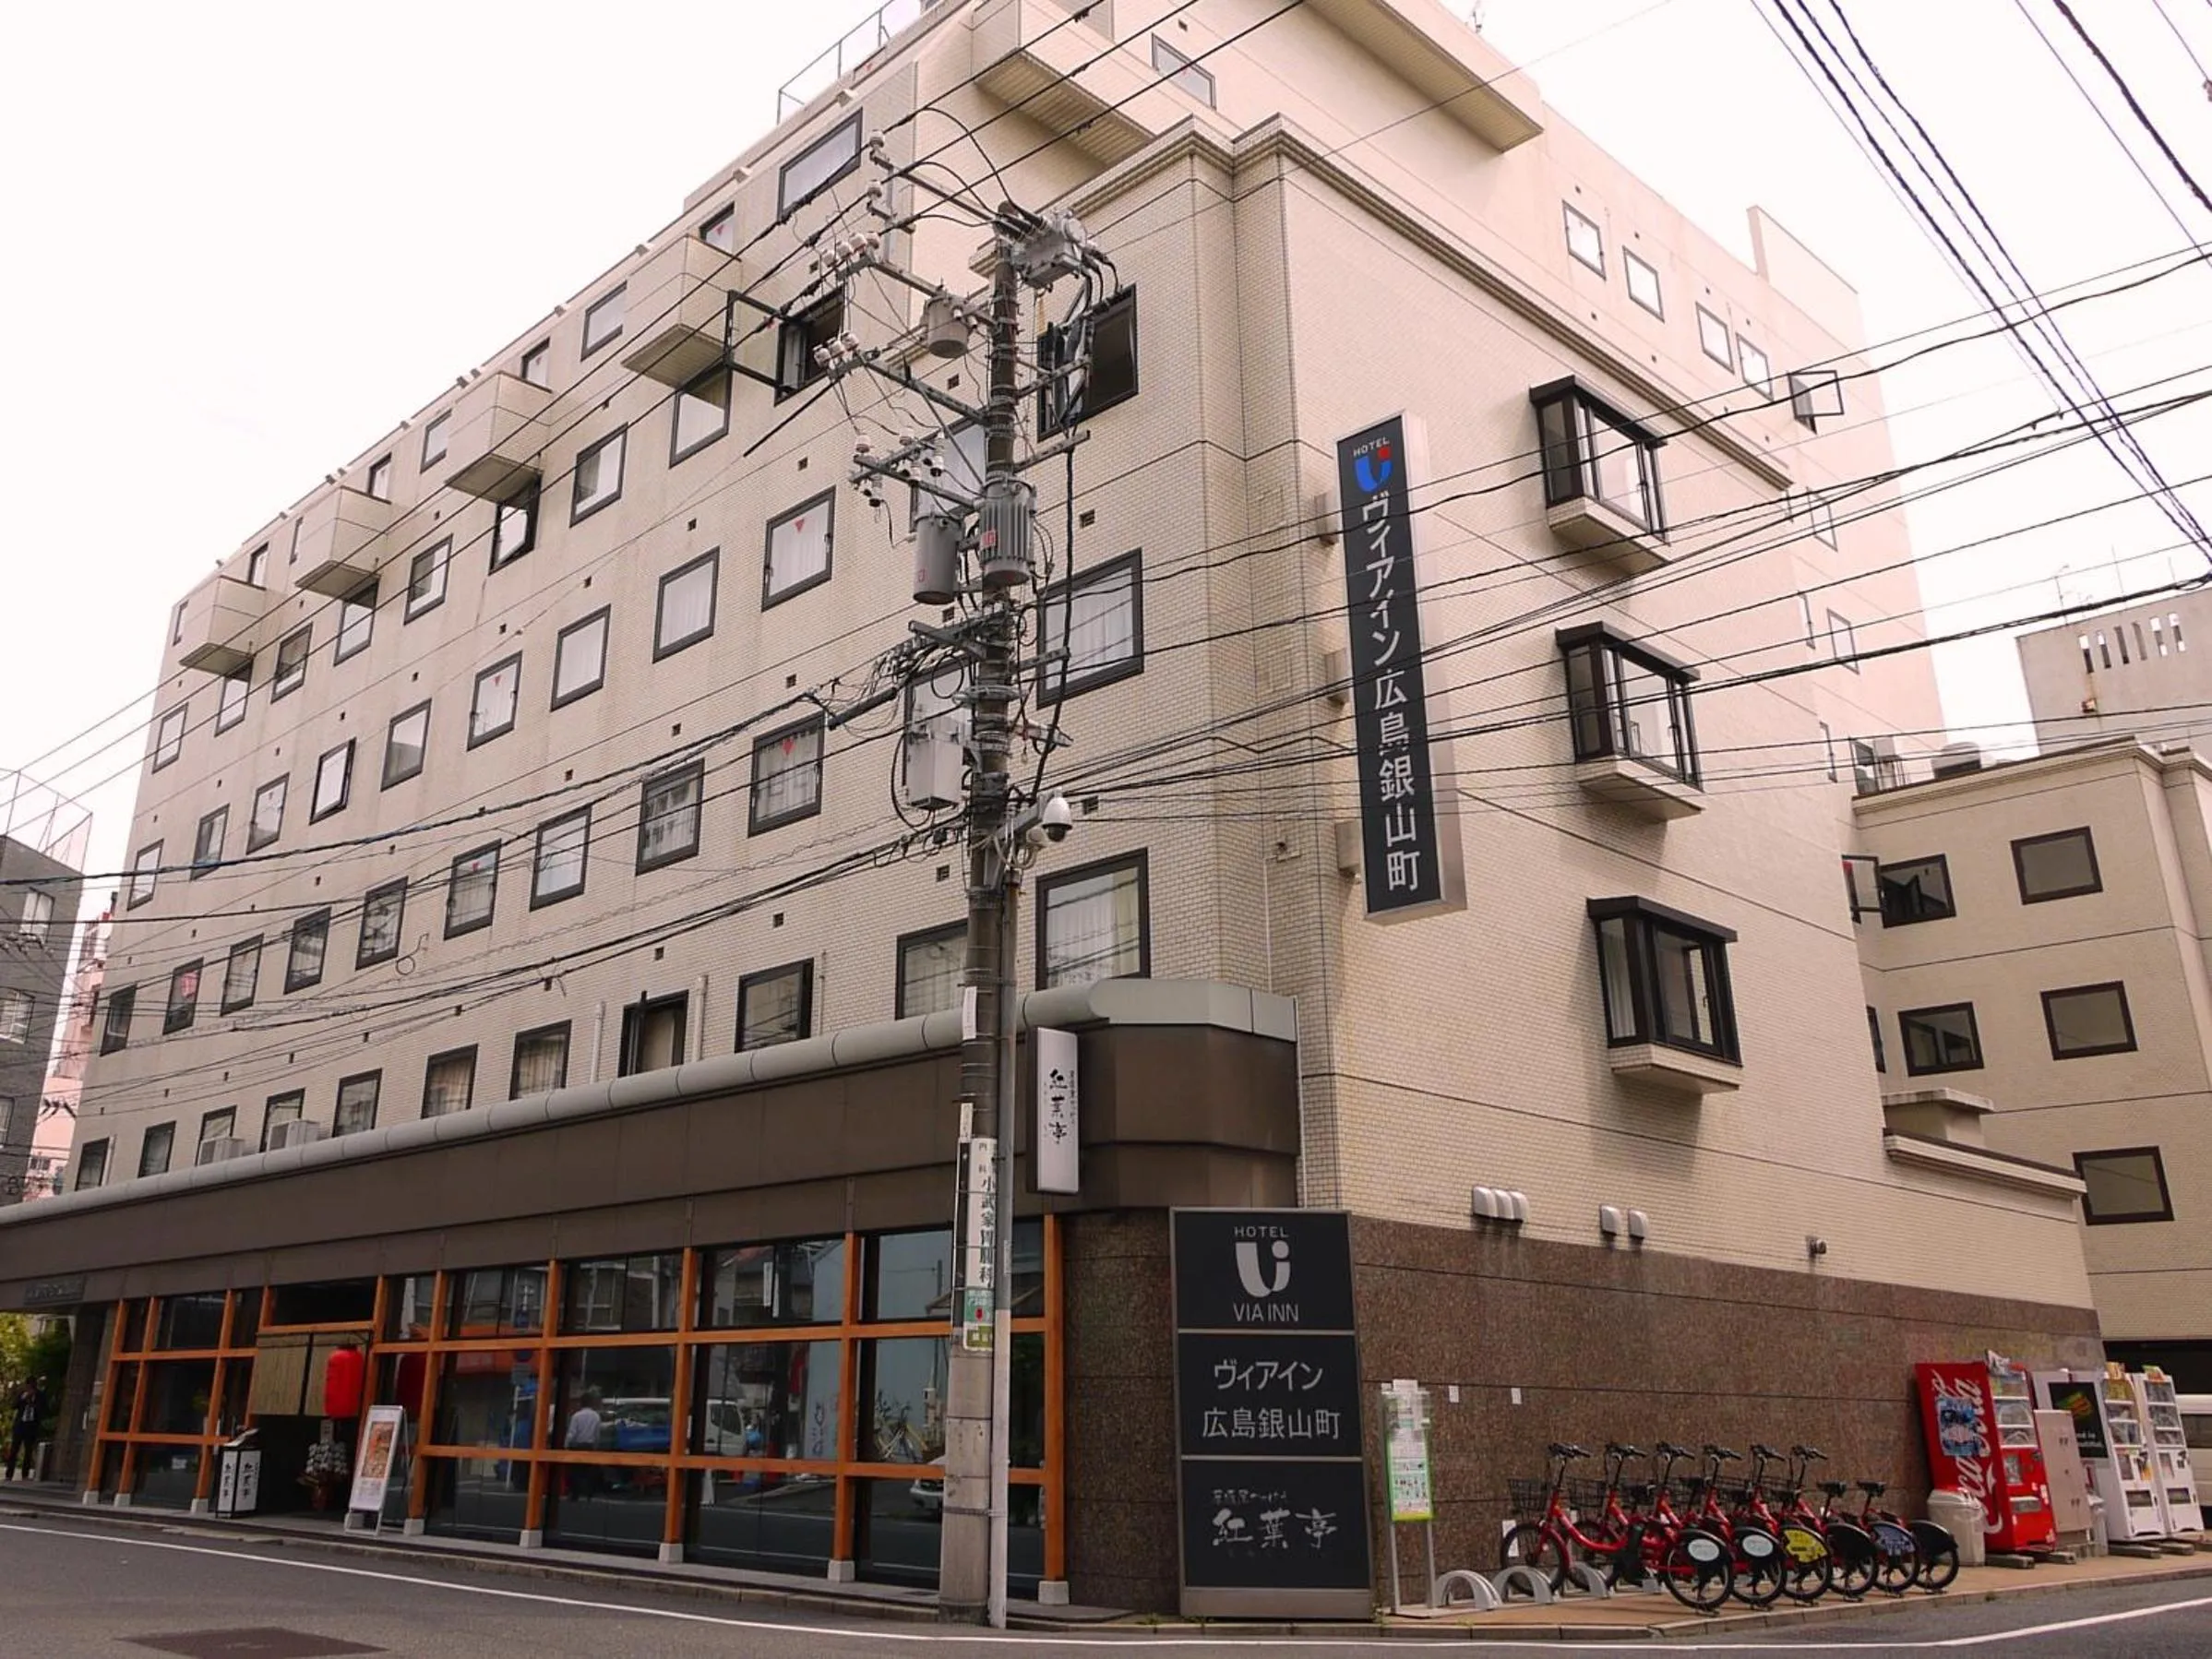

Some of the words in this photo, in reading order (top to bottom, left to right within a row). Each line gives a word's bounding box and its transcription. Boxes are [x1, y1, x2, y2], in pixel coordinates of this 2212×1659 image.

[1352, 436, 1391, 458] HOTEL
[1362, 491, 1422, 892] ヴィアイン広島銀山町
[1234, 1226, 1289, 1238] HOTEL
[1233, 1303, 1264, 1322] VIA
[1268, 1303, 1299, 1322] INN
[1214, 1358, 1323, 1392] ヴィアイン
[1202, 1406, 1341, 1441] 広島銀山町
[1212, 1507, 1338, 1550] 紅葉亭
